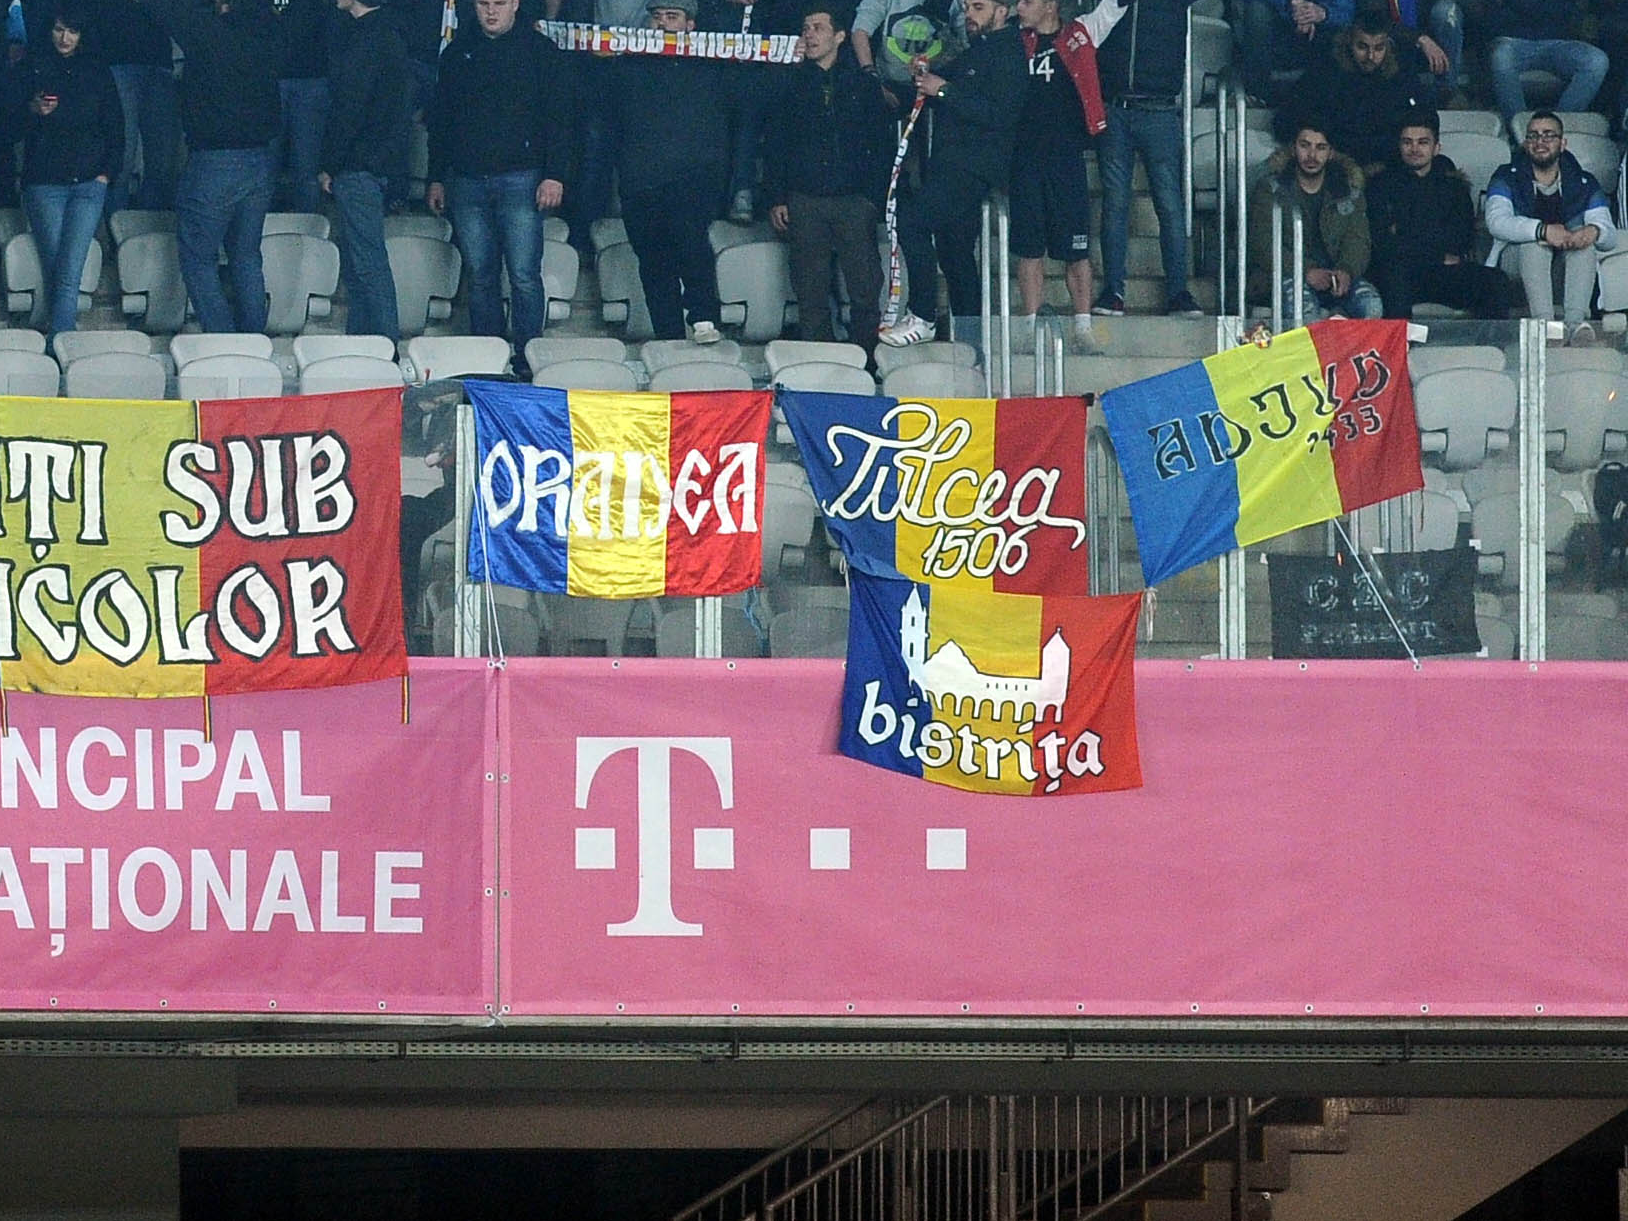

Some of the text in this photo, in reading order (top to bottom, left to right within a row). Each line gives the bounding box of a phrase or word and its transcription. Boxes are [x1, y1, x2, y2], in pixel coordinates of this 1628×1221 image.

[161, 432, 357, 548] SUB
[481, 439, 759, 537] ORADEA
[822, 403, 1086, 549] Tulcea
[923, 524, 1039, 578] 1506
